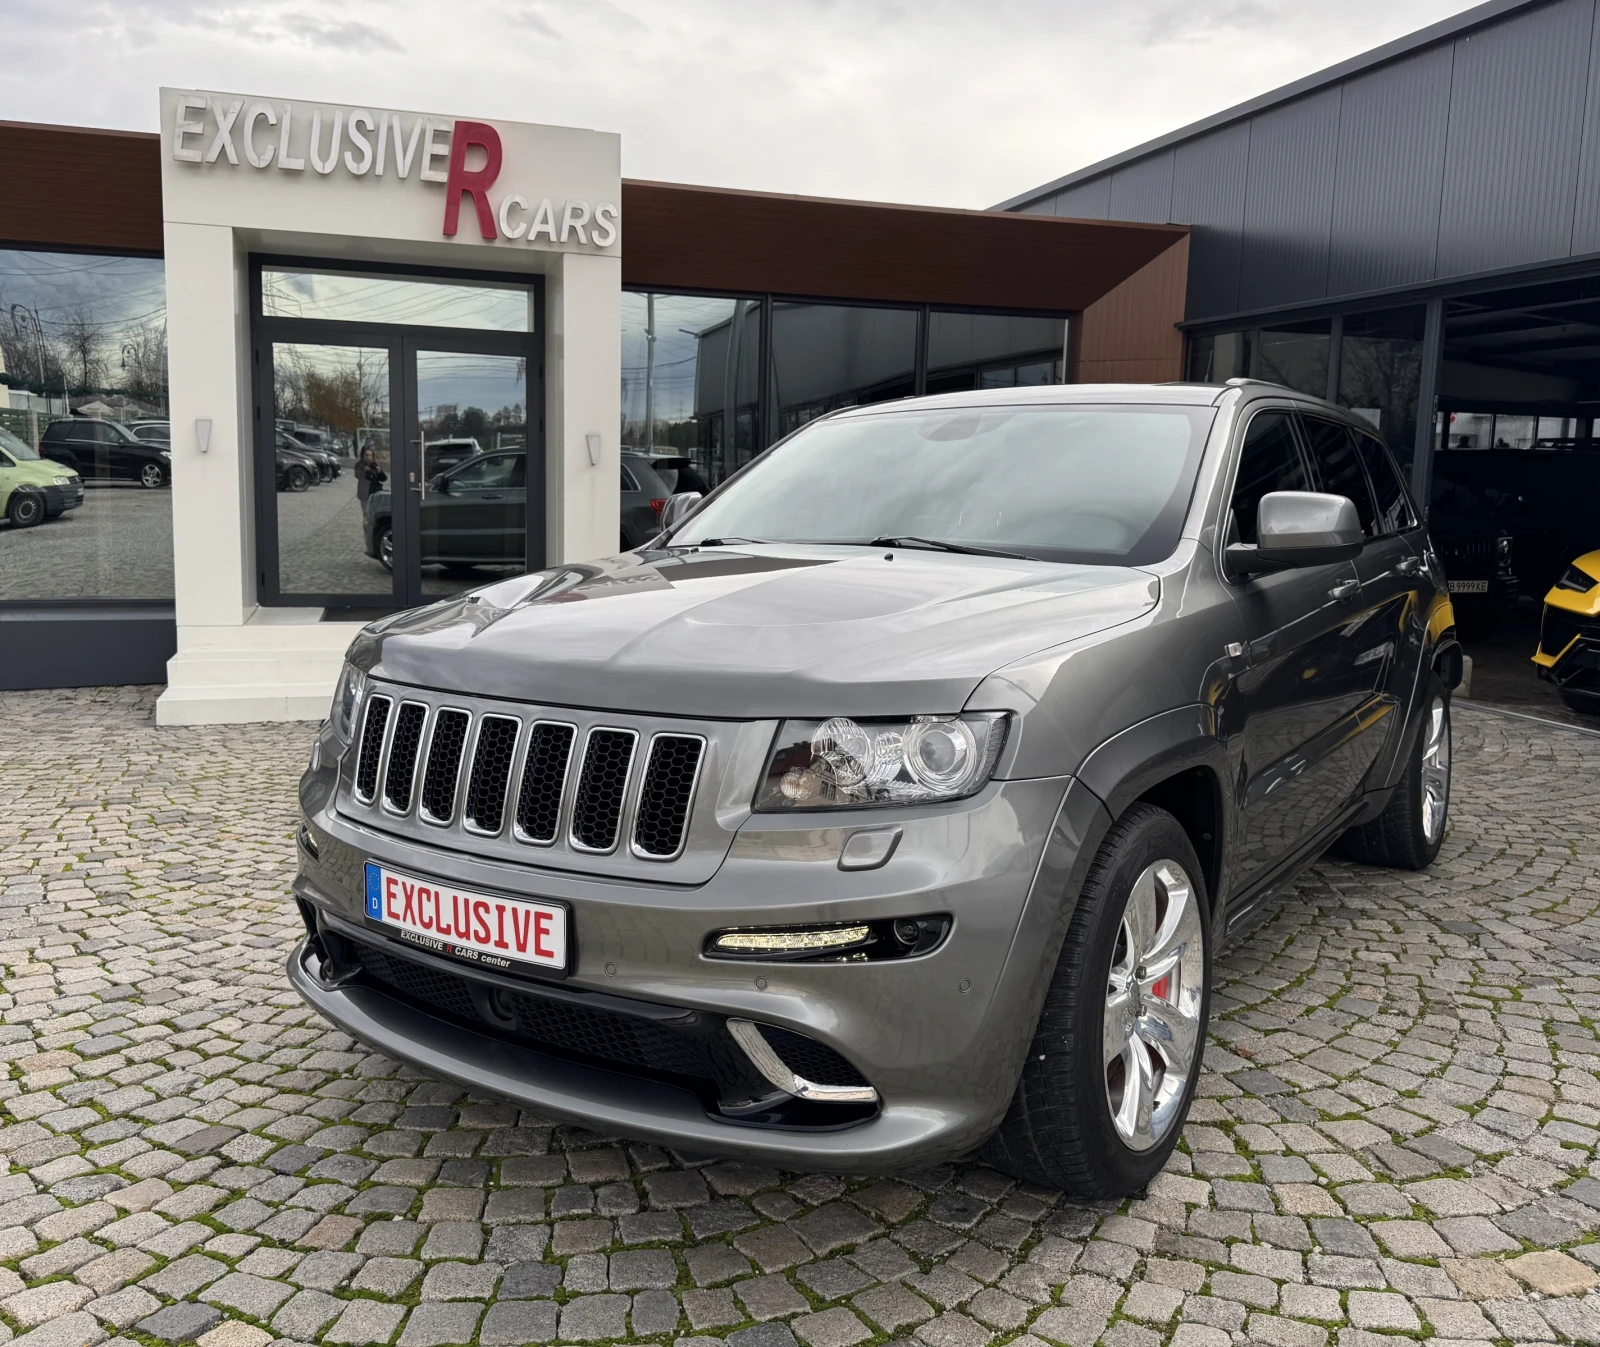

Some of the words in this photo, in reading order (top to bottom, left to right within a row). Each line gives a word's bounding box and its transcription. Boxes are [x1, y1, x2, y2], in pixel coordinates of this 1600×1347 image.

[173, 94, 453, 182] EXCLUSIVE
[443, 120, 503, 240] R
[499, 195, 618, 247] CARS
[372, 897, 378, 909] D
[386, 876, 554, 958] EXCLUSIVE
[401, 930, 443, 951] EXCLUSIVE
[446, 944, 453, 954] R
[455, 947, 479, 960] CARS
[481, 954, 511, 968] center
